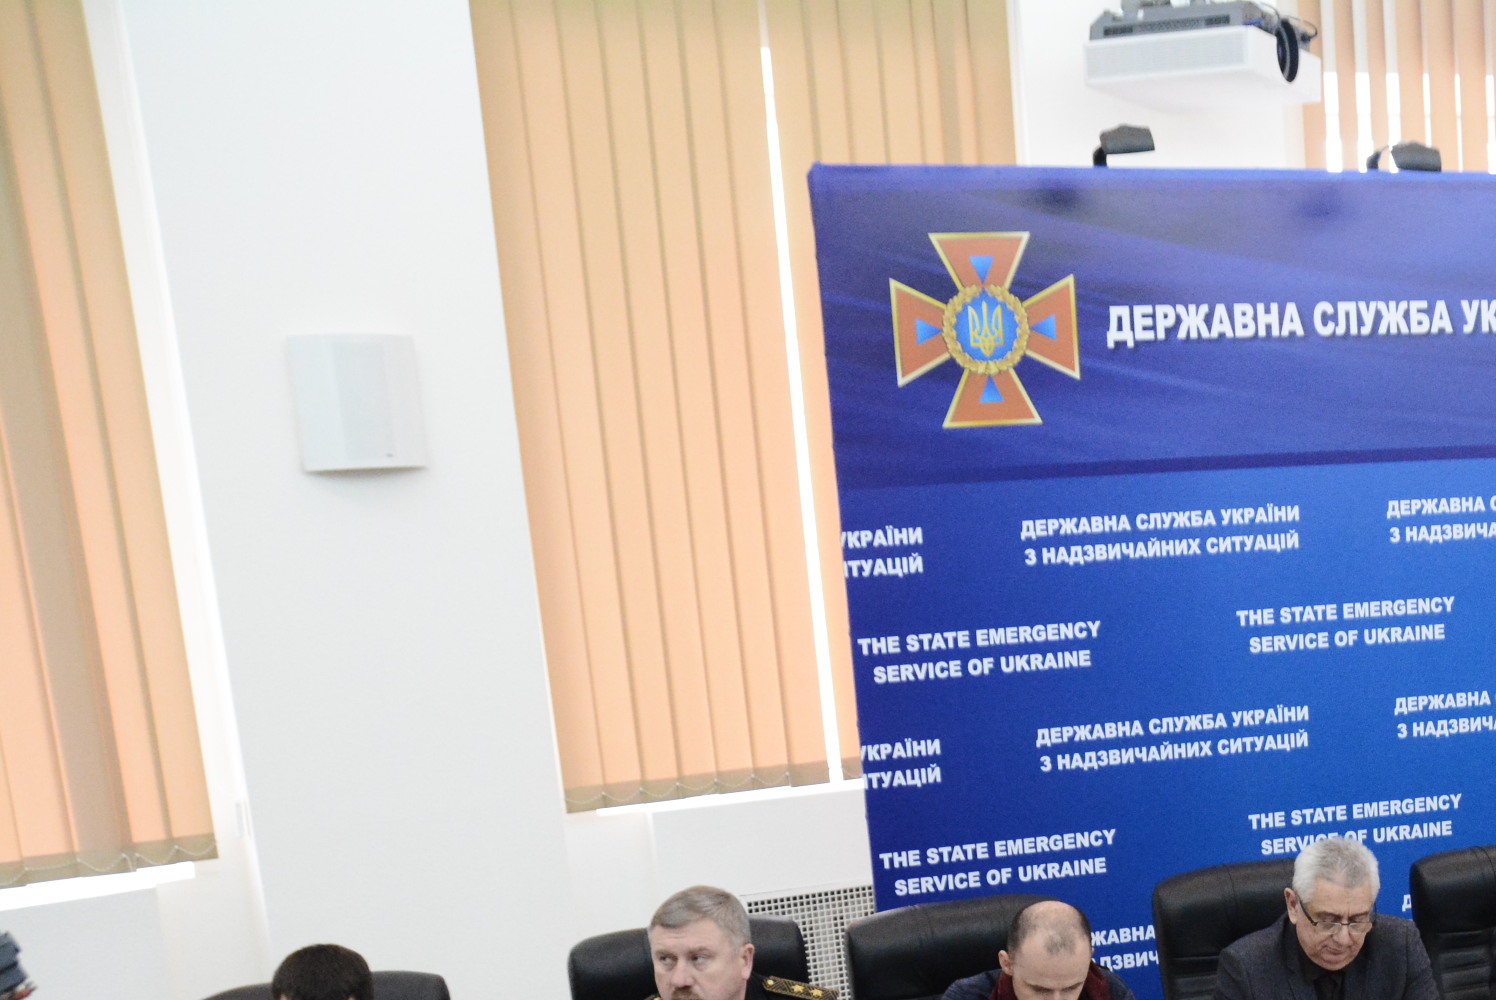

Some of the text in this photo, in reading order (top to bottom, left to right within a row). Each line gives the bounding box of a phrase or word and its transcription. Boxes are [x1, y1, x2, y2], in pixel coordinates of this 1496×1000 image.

[1106, 301, 1305, 350] ДЕРЖАВНА
[1313, 299, 1454, 337] СЛУЖБА
[1019, 502, 1301, 542] ДЕРЖАВНА СЛУЖБА УКРАЇНИ
[1386, 495, 1487, 520] ДЕРЖАВНА
[1023, 529, 1301, 567] З НАДЗВИЧАЙНИХ СИТУАЦІЙ
[1389, 526, 1402, 544] З
[1235, 595, 1456, 628] THE STATE EMERGENCY
[858, 619, 1102, 656] THE STATE EMERGENCY
[1248, 623, 1446, 655] SERVICE OF UKRAINE
[873, 649, 1093, 685] SERVICE OF UKRAINE
[1393, 689, 1492, 717] ДЕРЖАВНА
[1035, 703, 1310, 749] ДЕРЖАВНА СЛУЖБА УКРАЇНИ
[1396, 722, 1409, 740] З
[1039, 728, 1310, 773] З НАДЗВИЧАЙНИХ СИТУАЦІЙ
[1247, 792, 1463, 831] THE STATE EMERGENCY
[879, 827, 1117, 870] THE STATE EMERGENCY
[1372, 819, 1453, 844] UKRAINE
[894, 856, 1108, 896] SERVICE OF UKRAINE
